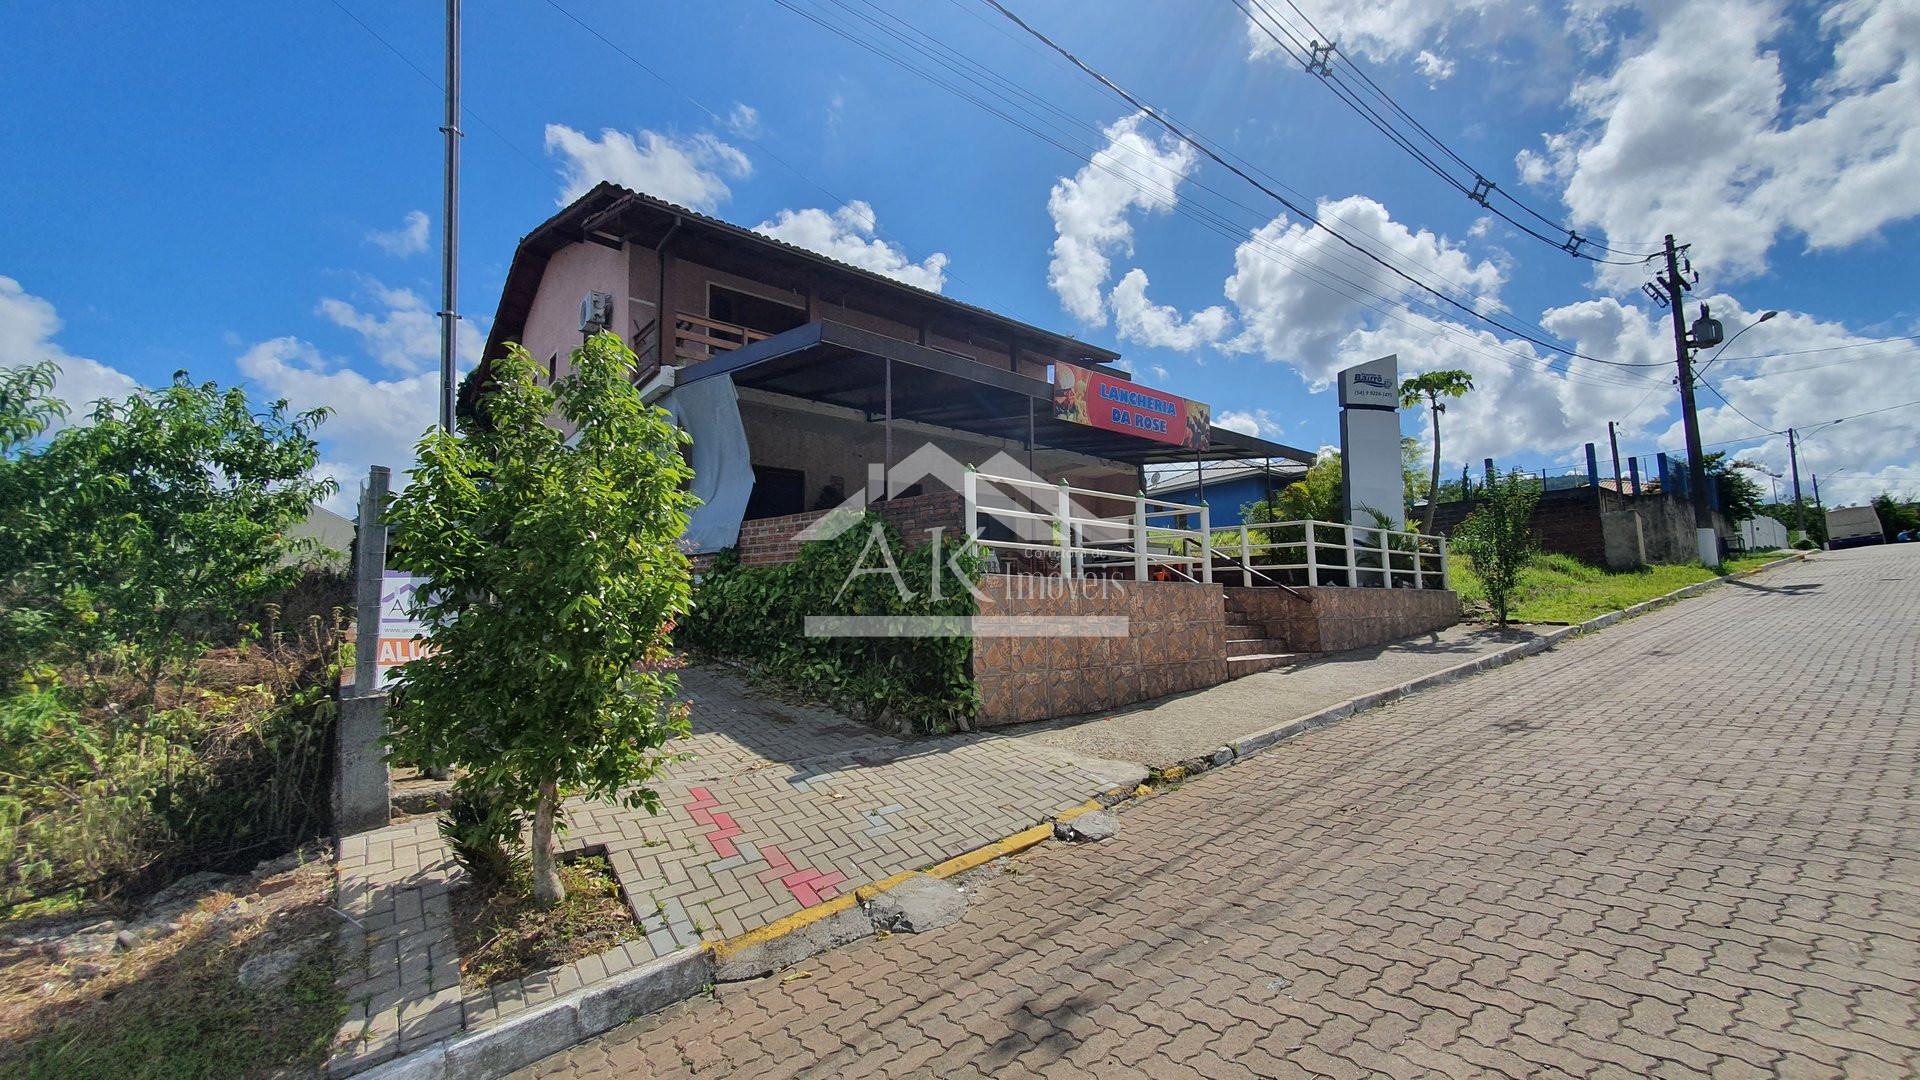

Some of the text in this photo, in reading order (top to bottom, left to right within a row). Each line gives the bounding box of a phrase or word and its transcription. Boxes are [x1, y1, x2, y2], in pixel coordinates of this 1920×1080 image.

[1100, 383, 1177, 417] LANCHERIA
[1111, 407, 1168, 434] DA ROSE
